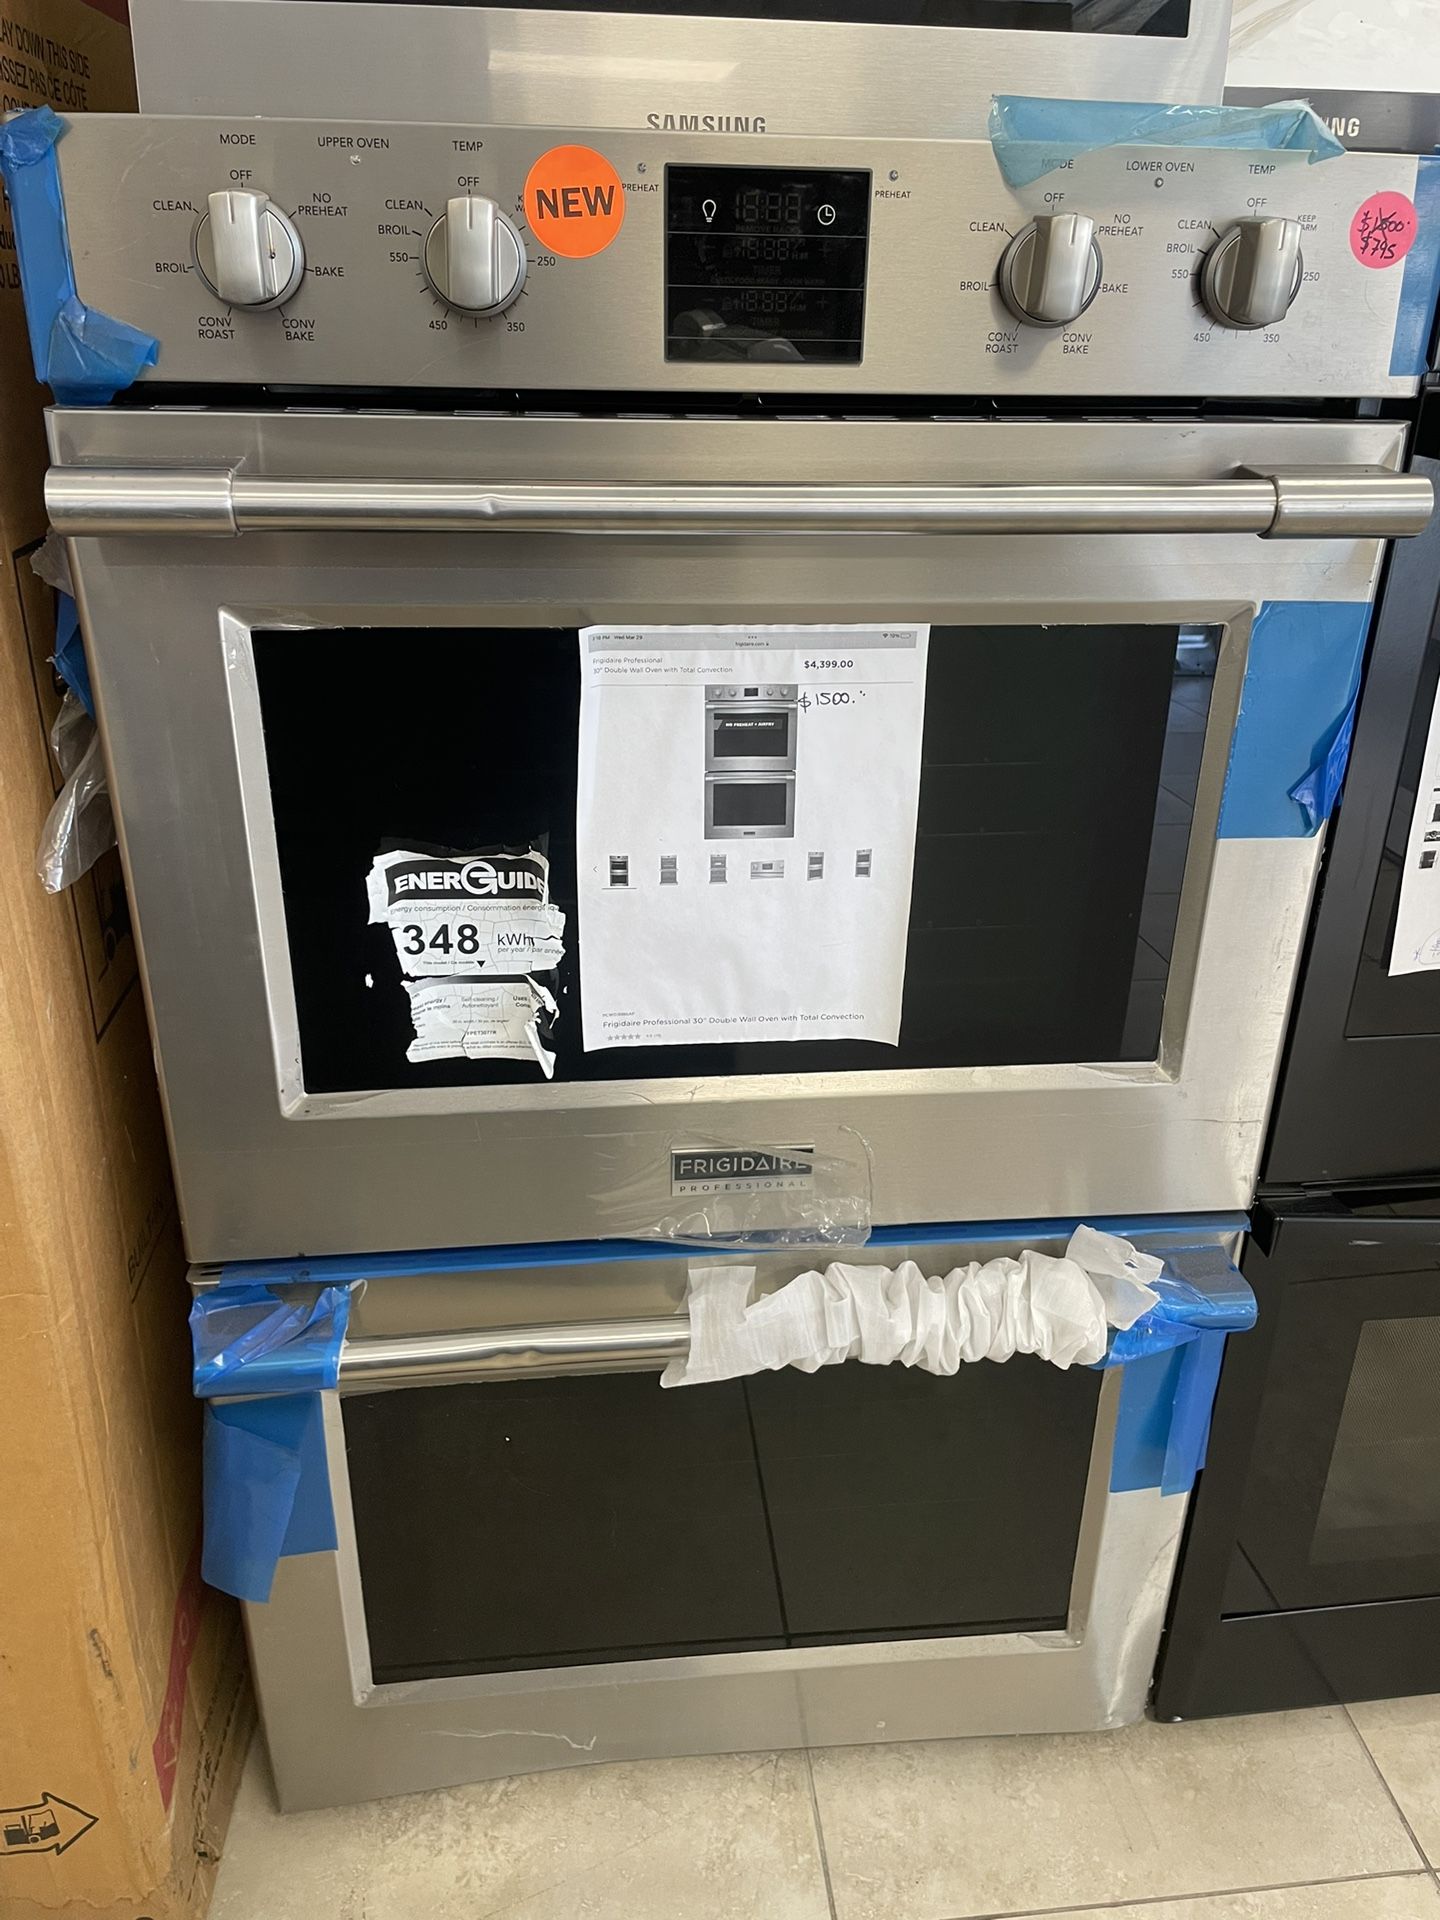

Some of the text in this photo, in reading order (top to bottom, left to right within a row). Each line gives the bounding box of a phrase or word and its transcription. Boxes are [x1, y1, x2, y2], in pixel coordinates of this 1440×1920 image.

[15, 24, 44, 61] DOWN
[46, 39, 68, 71] THIS
[68, 48, 91, 80] SIDE
[28, 67, 48, 98] PAS
[646, 113, 767, 133] SAMSUNG
[219, 134, 257, 145] MODE
[317, 137, 390, 149] UPPER OVEN
[452, 140, 484, 152] TEMP
[1041, 159, 1074, 169] MODE
[1126, 161, 1195, 172] LOWER OVEN
[1248, 165, 1276, 174] TEMP
[229, 169, 253, 181] OFF
[457, 176, 480, 188] OFF
[621, 183, 659, 192] PREHEAT
[312, 192, 332, 204] NO
[874, 190, 912, 199] PREHEAT
[1044, 192, 1065, 203] OFF
[152, 200, 192, 212] CLEAN
[385, 200, 423, 211] CLEAN
[536, 185, 615, 220] NEW
[1247, 198, 1267, 208] OFF
[297, 205, 348, 217] PREHEAT
[1114, 214, 1131, 224] NO
[1177, 219, 1212, 230] CLEAN
[378, 225, 411, 236] BROIL
[969, 222, 1005, 232] CLEAN
[1099, 226, 1144, 236] PREHEAT
[1301, 223, 1318, 232] ARM
[1166, 243, 1195, 253] BROIL
[1360, 231, 1396, 259] $795
[389, 252, 409, 263] 550
[537, 256, 556, 267] 250
[155, 263, 189, 274] BROIL
[314, 265, 345, 277] BAKE
[1171, 269, 1189, 279] 550
[1303, 271, 1320, 281] 250
[960, 281, 989, 291] BROIL
[1101, 284, 1128, 293] BAKE
[198, 316, 232, 328] CONV
[282, 318, 315, 330] CONV
[428, 320, 448, 331] 450
[506, 321, 525, 333] 350
[198, 328, 235, 340] ROAST
[285, 330, 315, 342] BAKE
[988, 332, 1018, 342] CONV
[1062, 333, 1093, 343] CONV
[1193, 332, 1211, 343] 450
[1263, 333, 1280, 343] 350
[985, 343, 1018, 354] ROAST
[1062, 345, 1089, 355] BAKE
[593, 656, 663, 665] Frigidaire Professional
[804, 659, 854, 670] $4,399.00
[605, 666, 628, 674] Double
[697, 666, 733, 674] Convection
[394, 861, 545, 895] ENERGUIDE
[413, 904, 462, 913] consumption
[467, 904, 522, 912] Consommation
[402, 924, 480, 955] 348
[498, 933, 531, 946] kWh
[603, 1019, 641, 1029] Frigidaire
[643, 1017, 690, 1026] Professional
[820, 1013, 864, 1021] Convection
[679, 1181, 806, 1193] PROFESSIONAL
